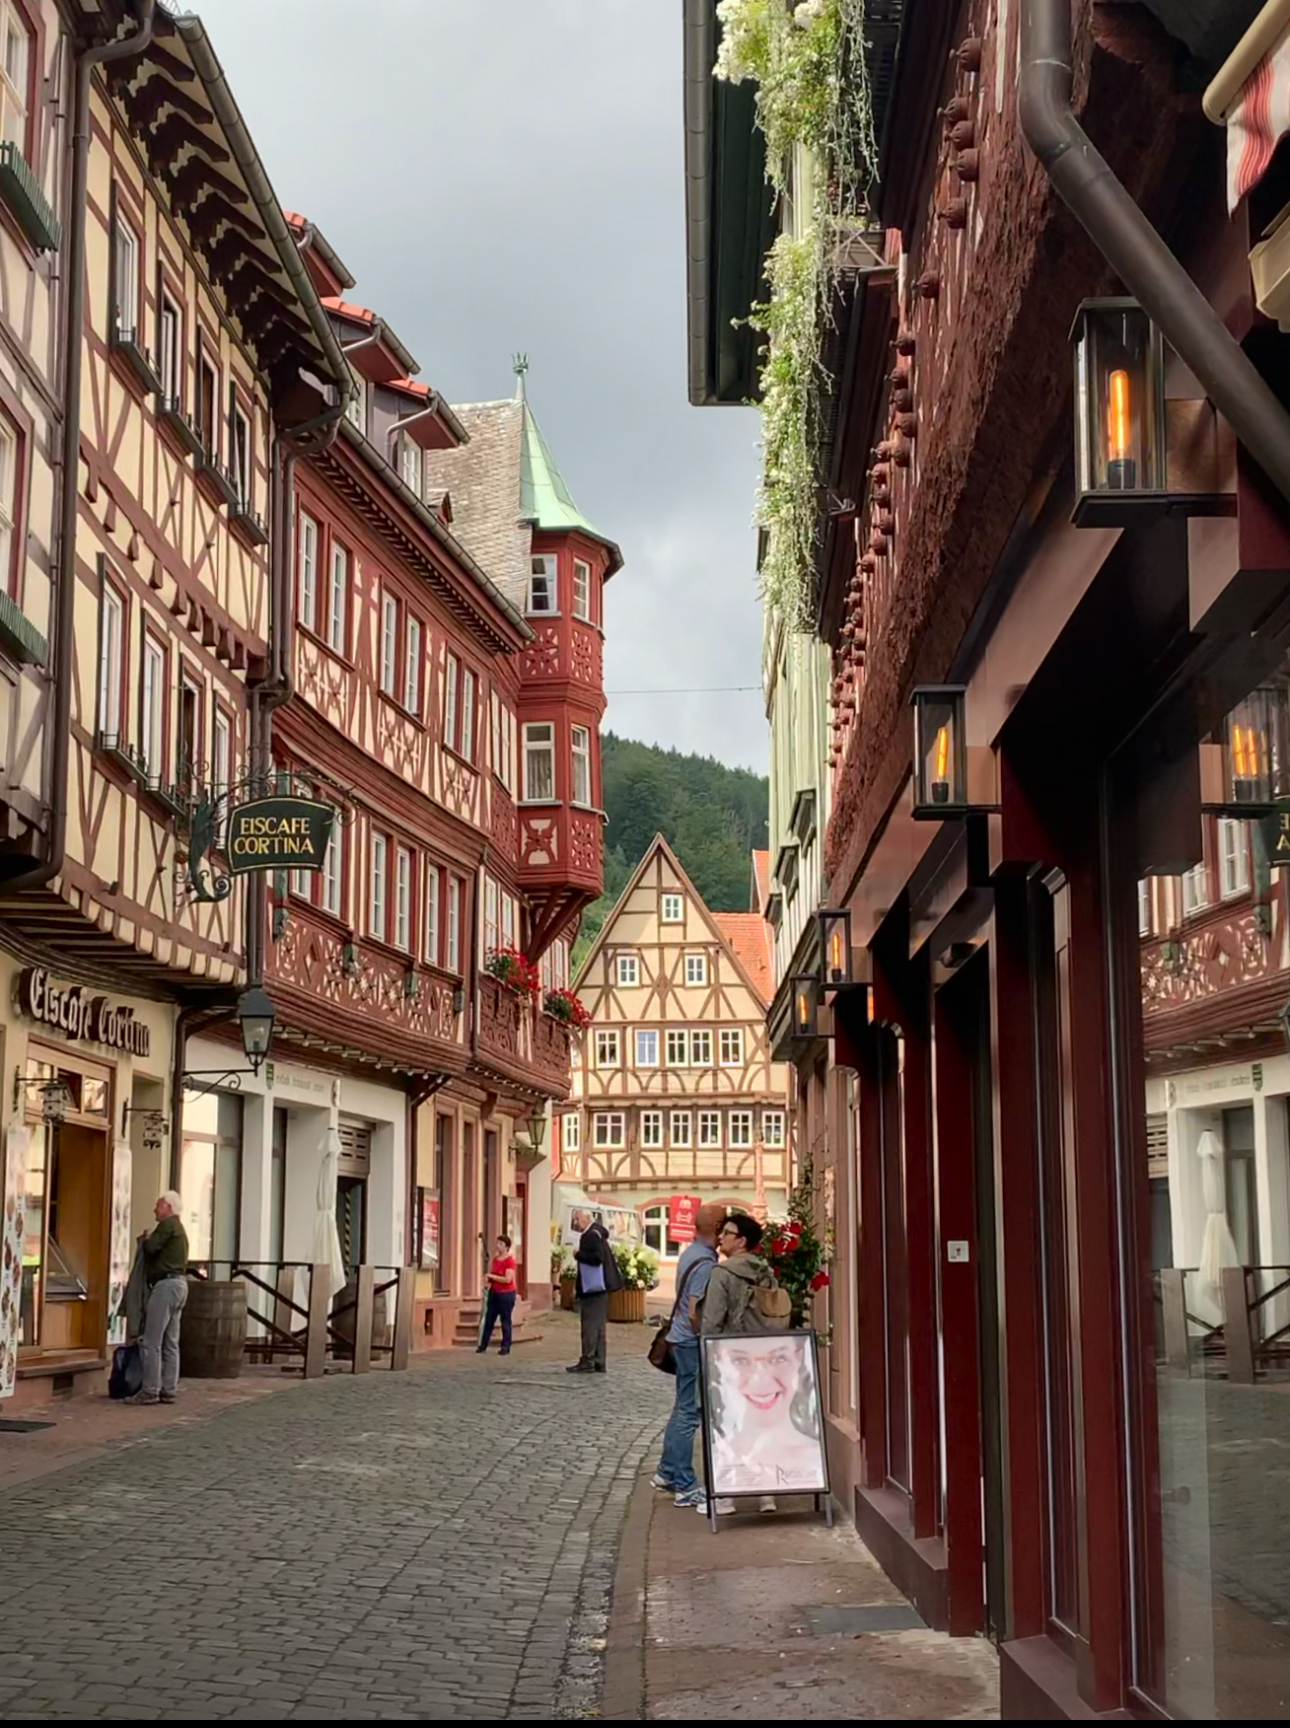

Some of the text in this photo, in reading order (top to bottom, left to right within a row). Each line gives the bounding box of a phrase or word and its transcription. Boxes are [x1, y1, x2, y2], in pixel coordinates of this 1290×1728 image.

[240, 817, 310, 835] EISCAFE
[234, 837, 314, 854] CORTINA
[98, 997, 151, 1057] Cortina
